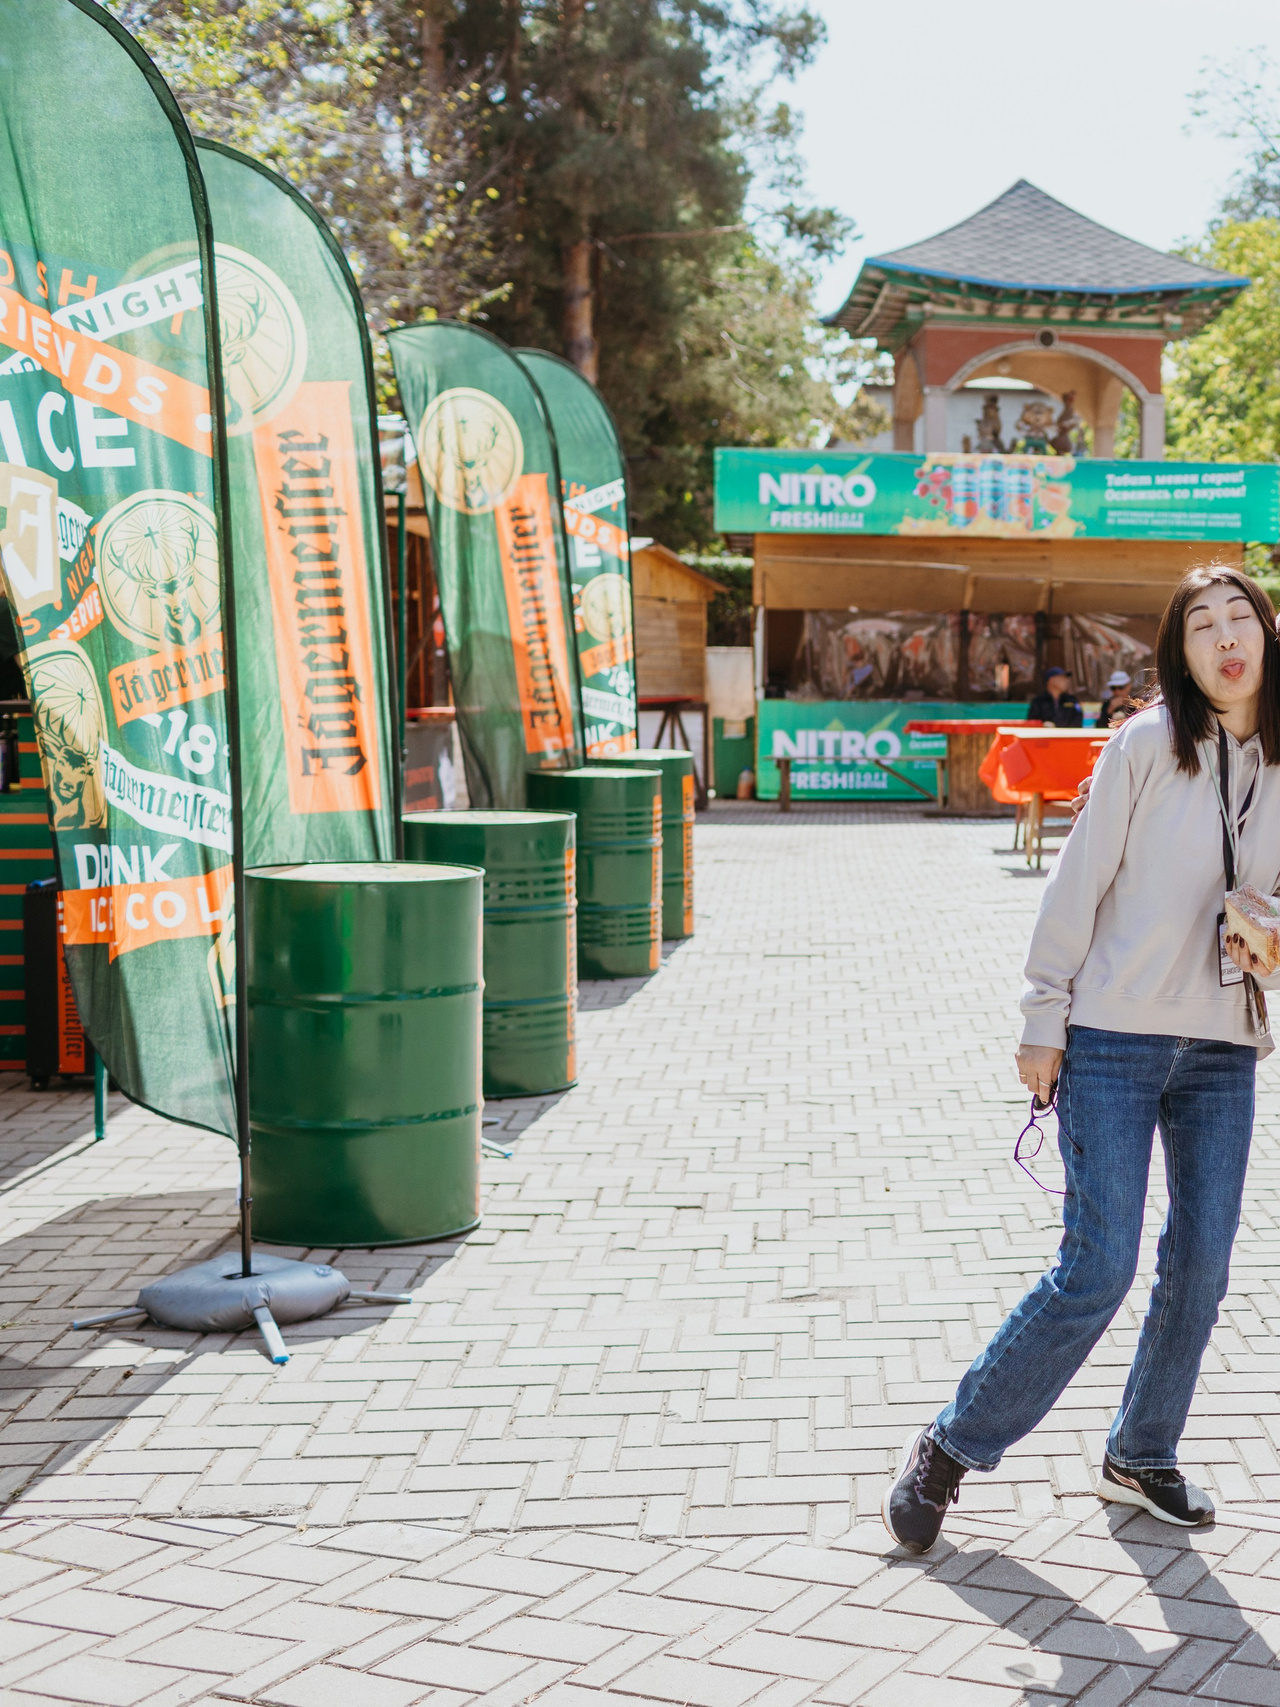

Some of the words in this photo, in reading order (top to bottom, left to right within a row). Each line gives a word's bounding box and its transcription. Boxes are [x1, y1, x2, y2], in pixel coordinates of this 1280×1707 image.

[758, 473, 876, 507] NITRO
[773, 730, 901, 765] NITRO
[125, 886, 222, 930] COL
